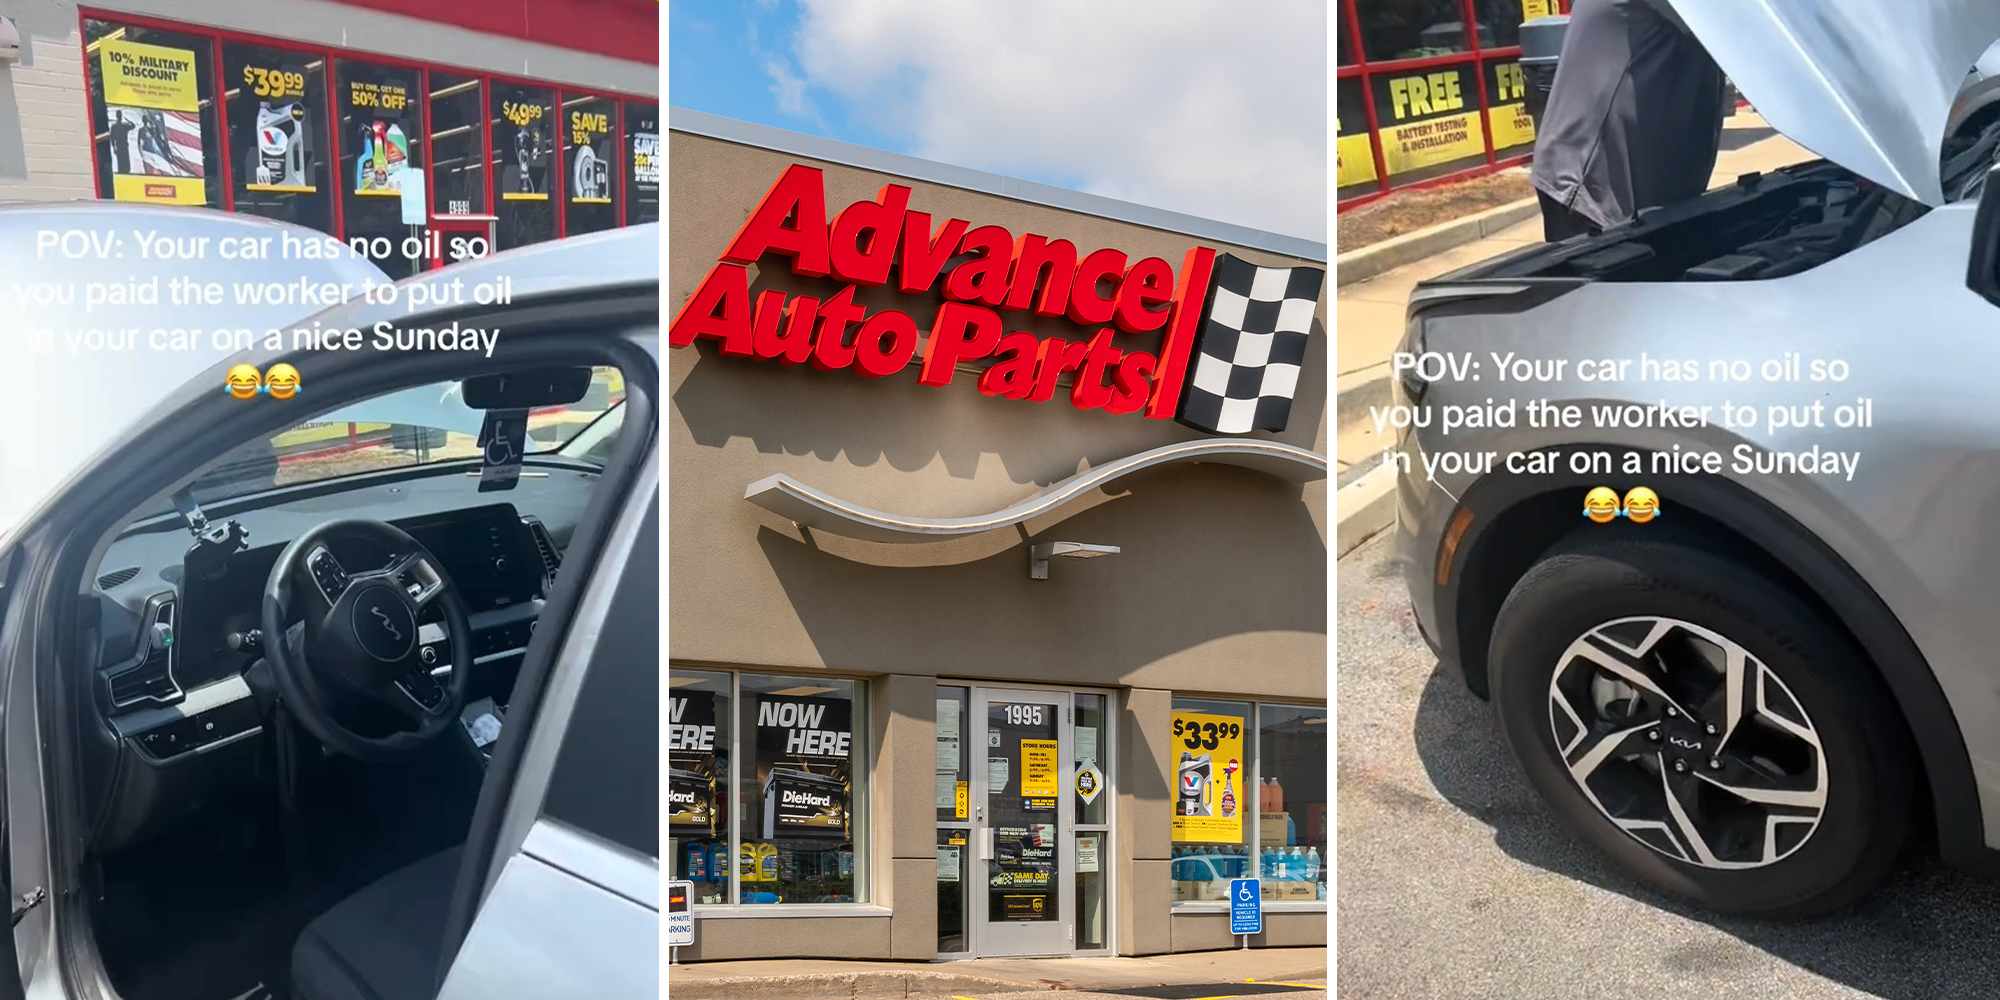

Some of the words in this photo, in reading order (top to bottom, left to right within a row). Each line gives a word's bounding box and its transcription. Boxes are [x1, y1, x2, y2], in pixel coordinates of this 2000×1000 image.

[108, 51, 134, 64] 10%
[139, 56, 188, 72] MILITARY
[122, 65, 178, 82] DISCOUNT
[351, 82, 364, 90] BUY
[365, 84, 380, 93] ONE,
[380, 85, 392, 93] GET
[393, 86, 405, 95] ONE
[1390, 71, 1463, 119] FREE
[352, 90, 379, 107] 50%
[382, 94, 406, 110] OFF
[572, 111, 608, 133] SAVE
[1397, 124, 1432, 141] BATTERY
[1435, 117, 1467, 132] TESTING
[572, 131, 590, 145] 15%
[1402, 142, 1409, 152] &
[1411, 131, 1467, 151] INSTALLATION
[718, 163, 1175, 333] Advance
[669, 262, 919, 378] Auto
[917, 300, 1156, 415] Parts
[757, 701, 826, 728] NOW
[1004, 705, 1042, 726] 1995
[786, 728, 851, 756] HERE
[782, 790, 830, 806] DieHard
